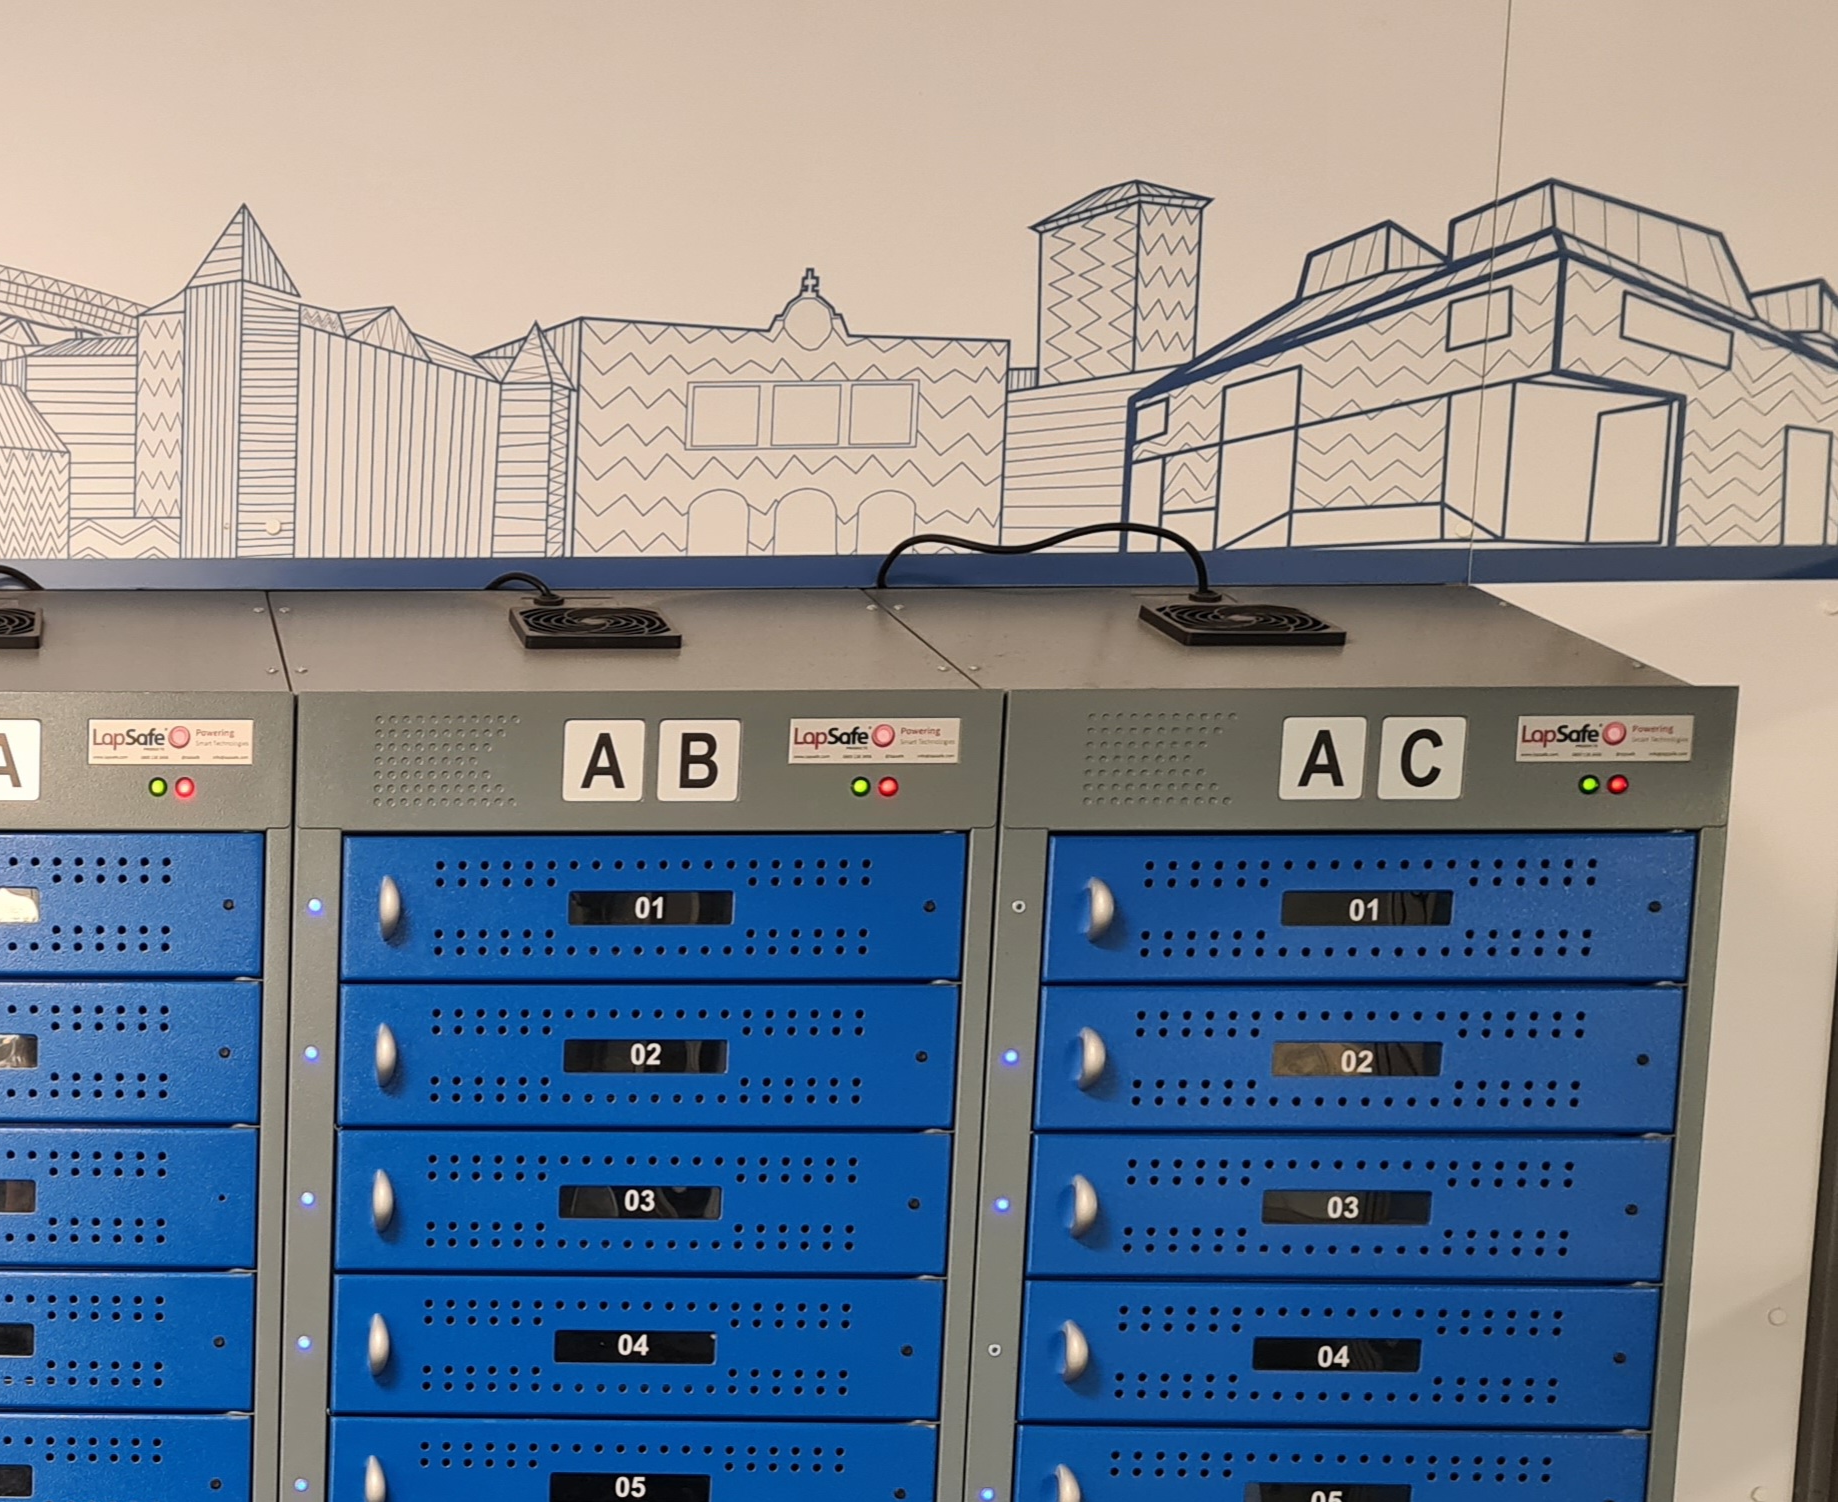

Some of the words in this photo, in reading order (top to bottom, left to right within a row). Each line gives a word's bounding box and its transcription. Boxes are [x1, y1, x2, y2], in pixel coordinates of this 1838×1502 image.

[196, 729, 234, 738] Powering
[901, 728, 940, 736] Powering
[581, 733, 625, 788] A
[679, 733, 718, 788] B
[1298, 729, 1344, 786] A
[1400, 729, 1443, 787] C
[636, 897, 663, 918] 01
[1350, 899, 1378, 921] 01
[631, 1043, 661, 1065] 02
[1341, 1050, 1373, 1073] 02
[625, 1190, 654, 1211] 03
[1328, 1197, 1358, 1218] 03
[618, 1334, 648, 1355] 04
[1318, 1346, 1349, 1367] 04
[616, 1477, 645, 1497] 05
